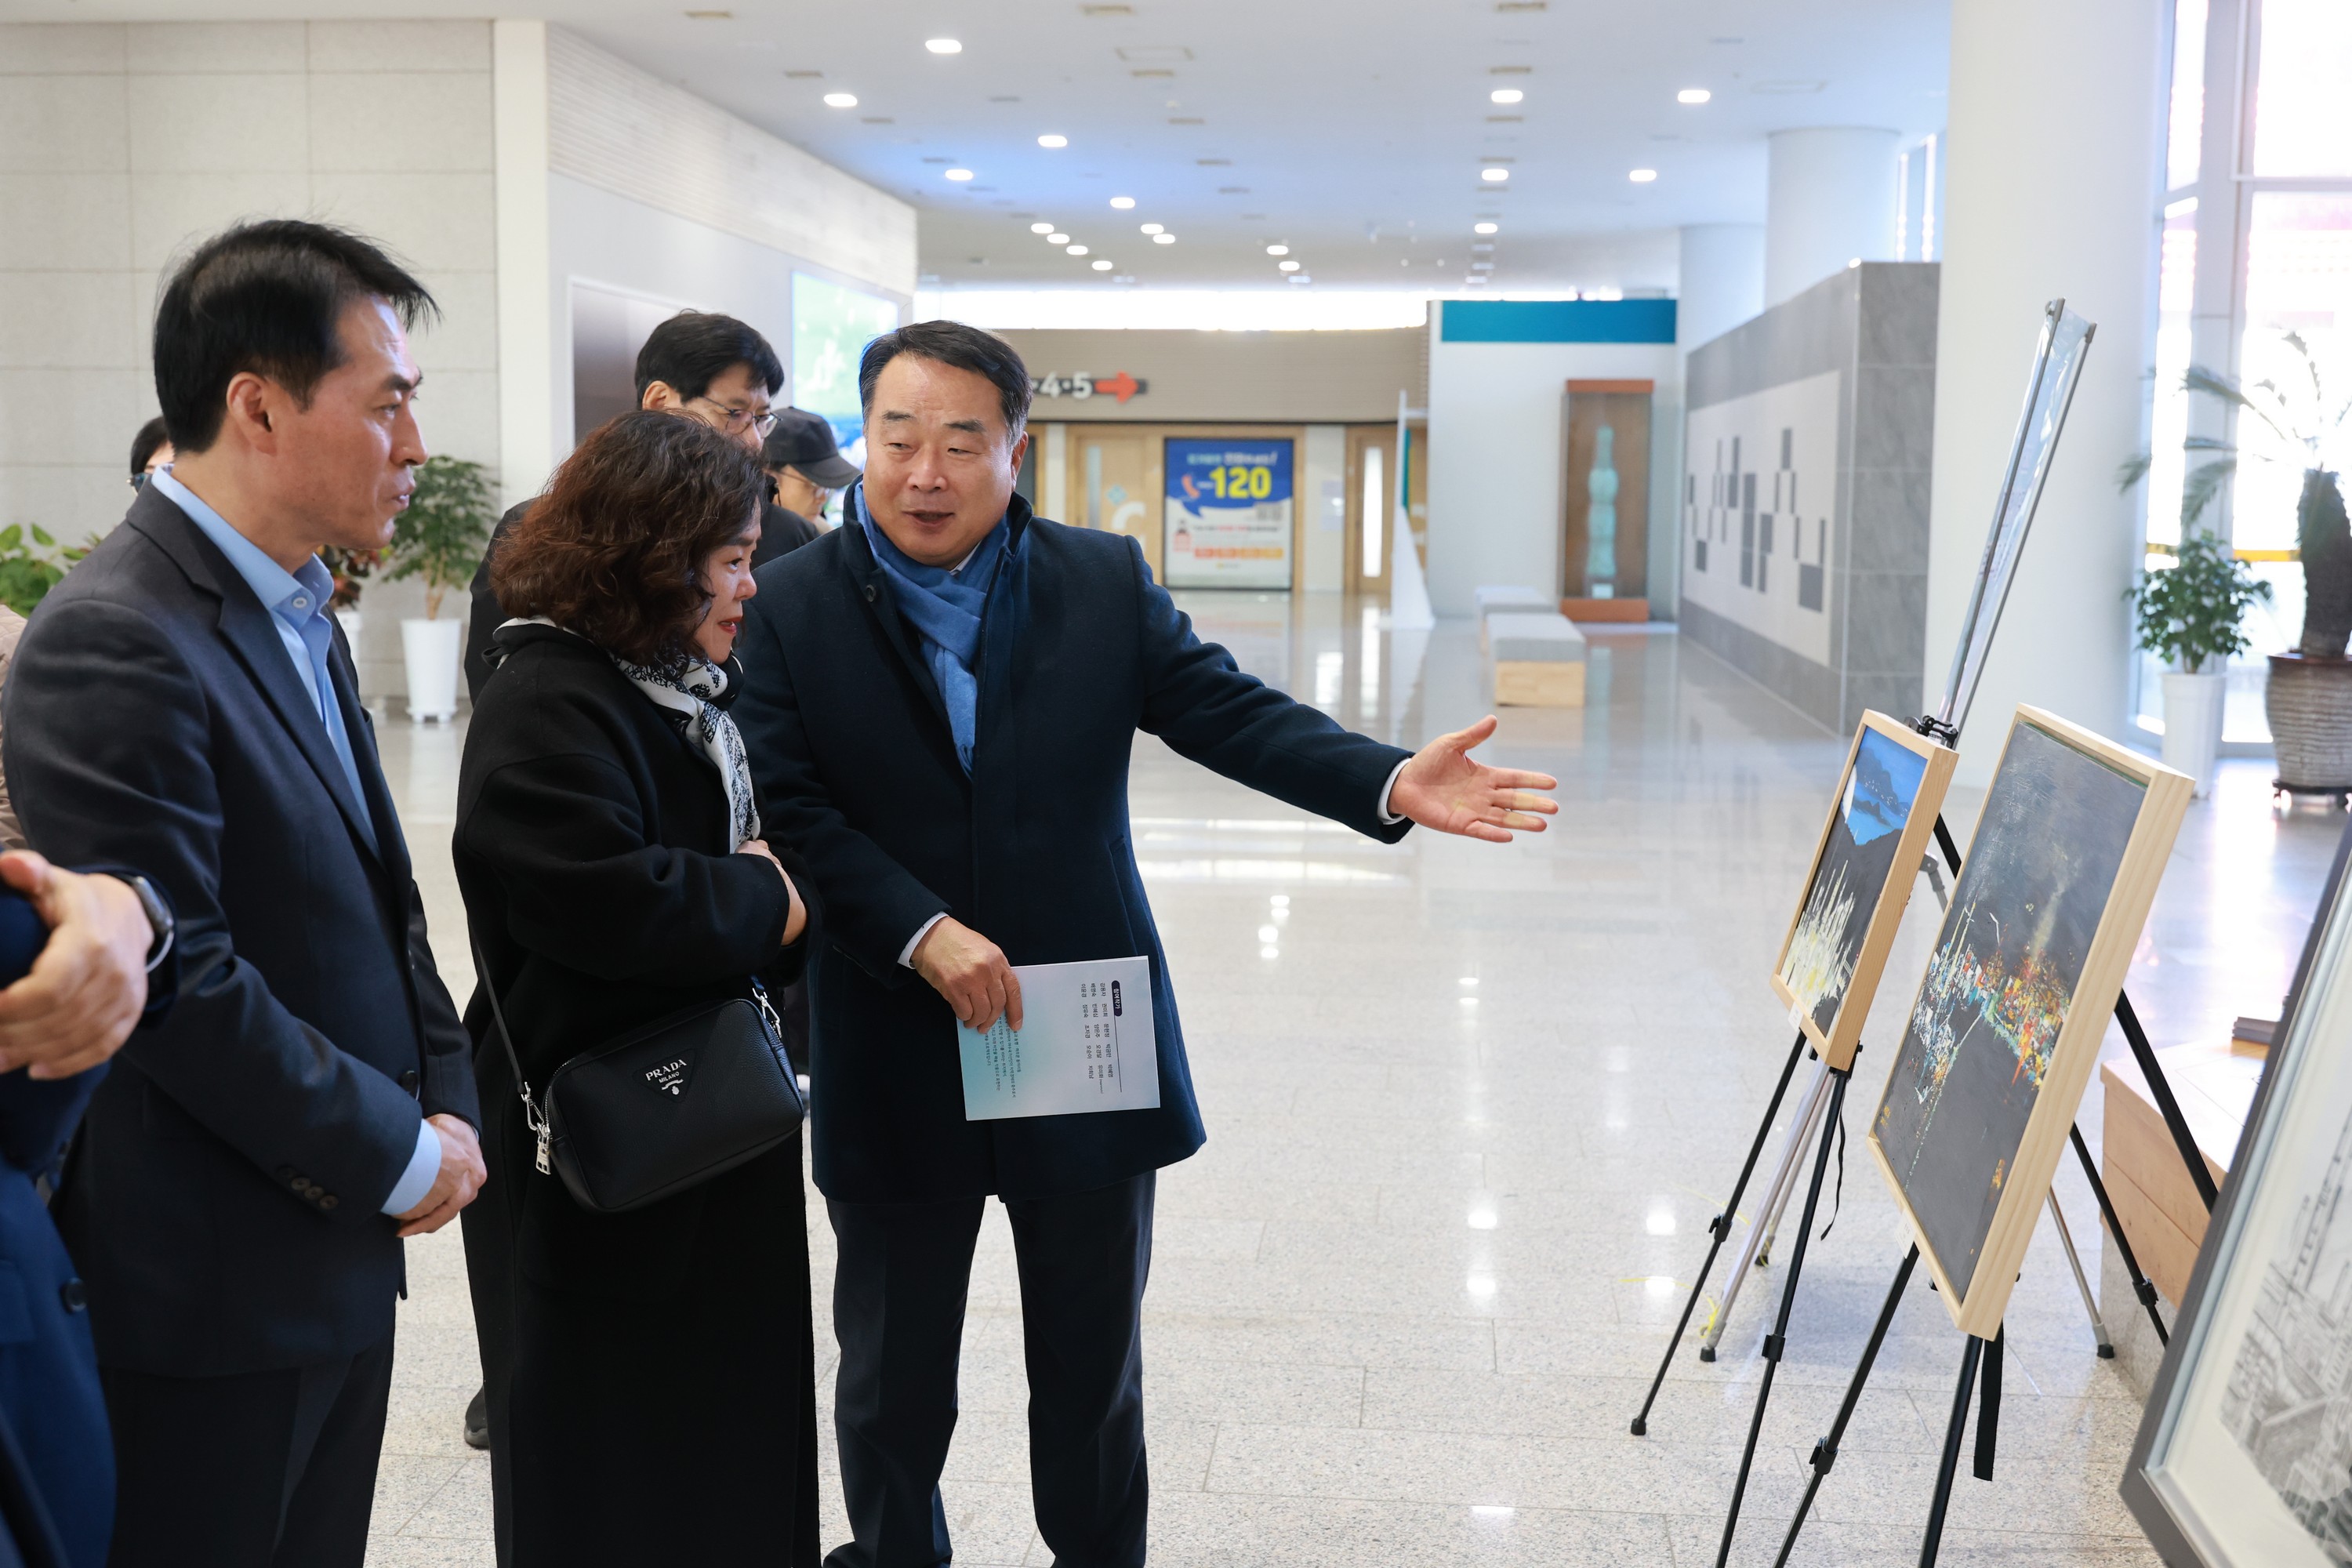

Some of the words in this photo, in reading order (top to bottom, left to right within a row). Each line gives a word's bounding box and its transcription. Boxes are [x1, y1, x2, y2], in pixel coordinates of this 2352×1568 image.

[1210, 466, 1272, 499] 120
[645, 1059, 687, 1081] PRADA
[659, 1072, 680, 1083] MILANO
